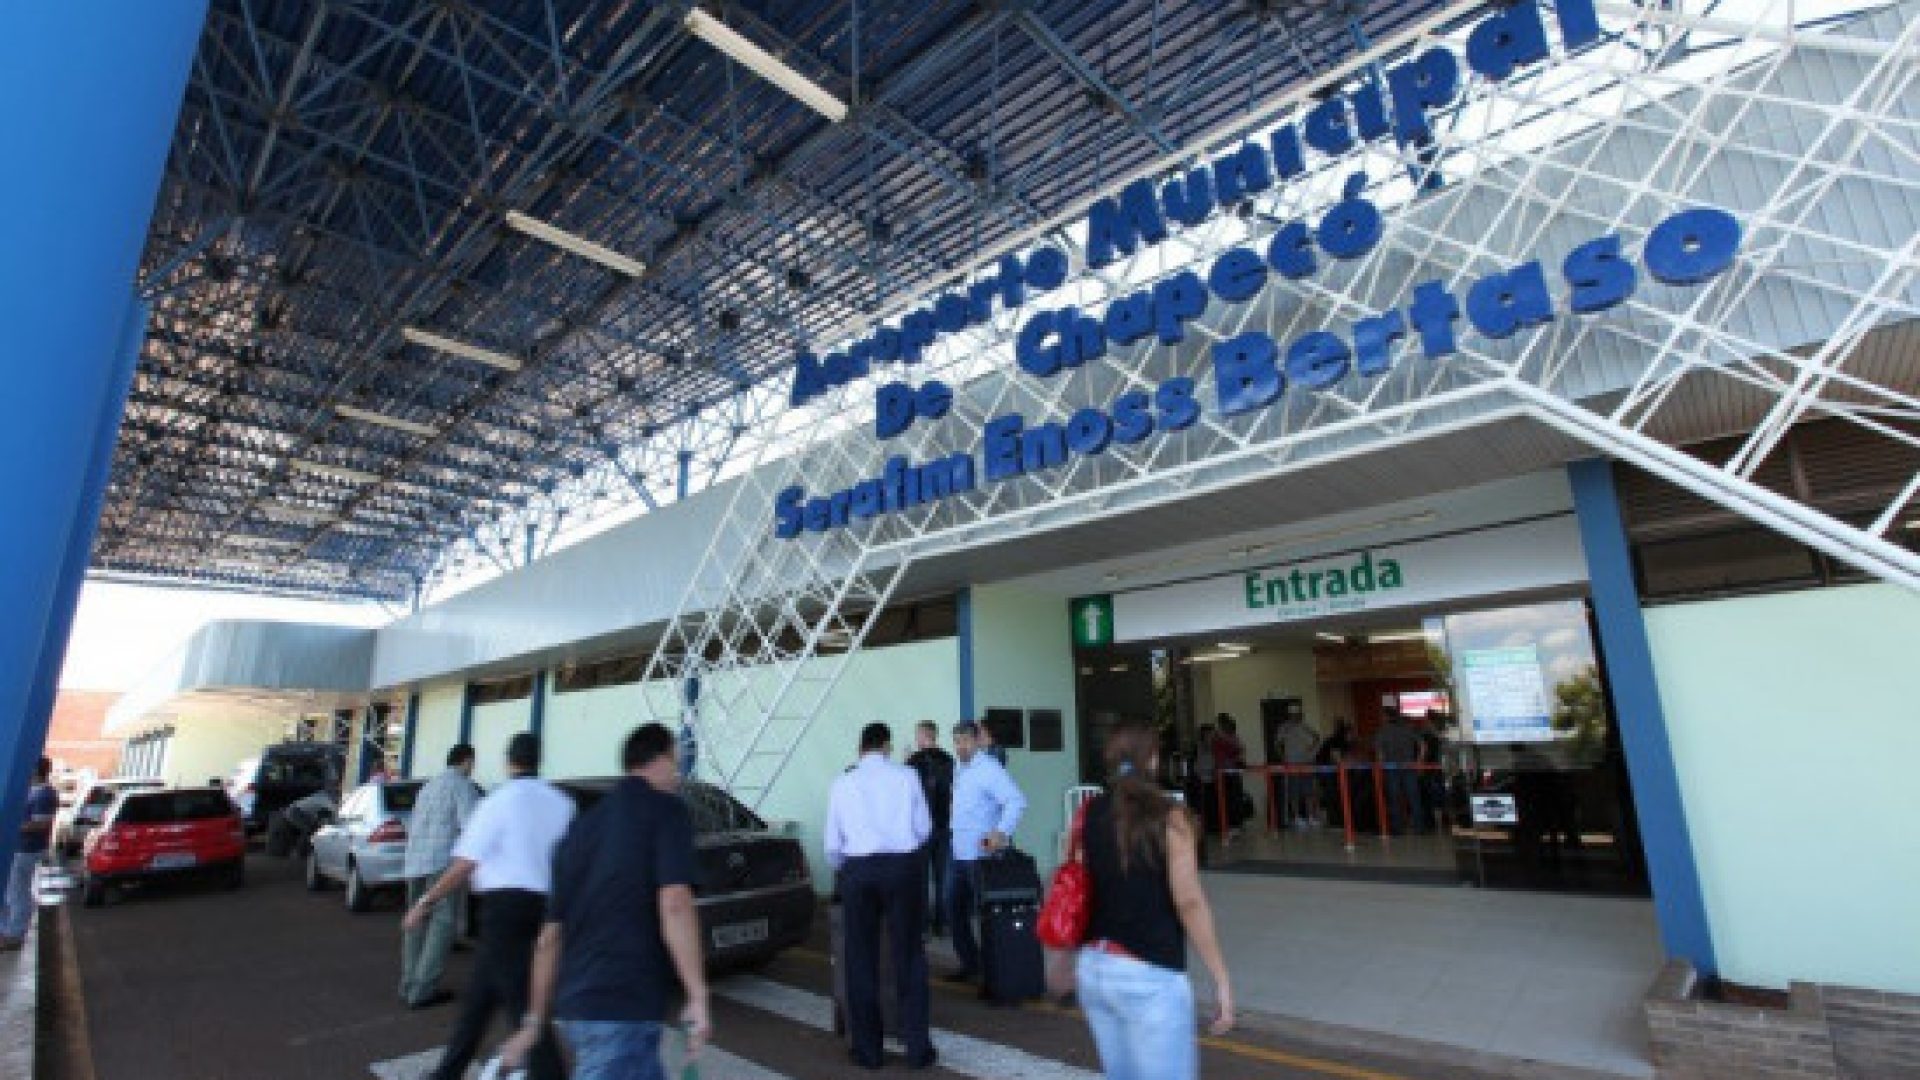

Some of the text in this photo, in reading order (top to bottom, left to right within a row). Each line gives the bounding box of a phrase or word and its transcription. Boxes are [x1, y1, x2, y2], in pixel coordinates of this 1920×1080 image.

[775, 208, 1742, 539] Serafim Enoss Bertaso
[876, 171, 1383, 440] De Chapecó
[1245, 551, 1403, 609] Entrada
